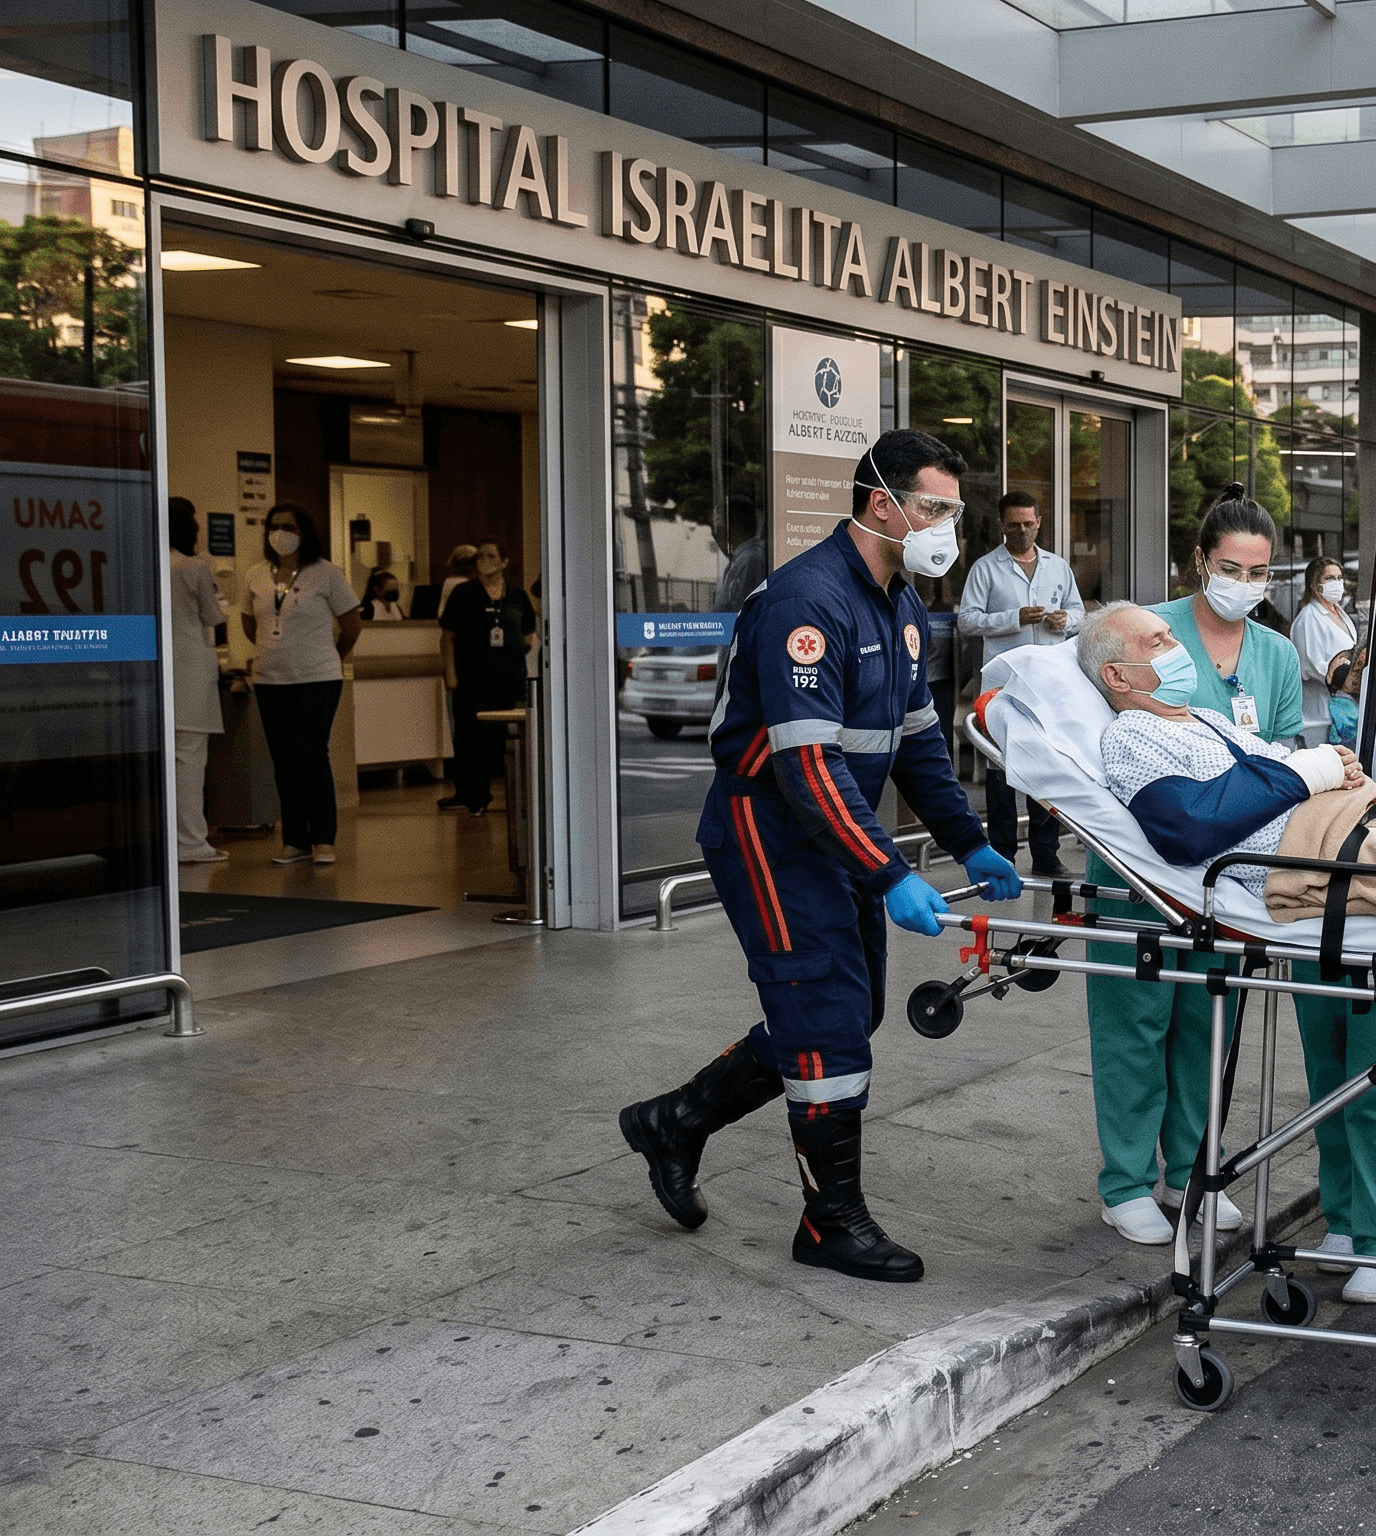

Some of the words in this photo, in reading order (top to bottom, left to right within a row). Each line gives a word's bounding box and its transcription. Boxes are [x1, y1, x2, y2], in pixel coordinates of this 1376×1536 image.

[203, 34, 588, 228] HOSPITAL
[602, 151, 872, 298] ISRAELITA
[880, 236, 1034, 335] ALBERT
[1041, 279, 1179, 373] EINSTEIN
[792, 675, 819, 688] 192
